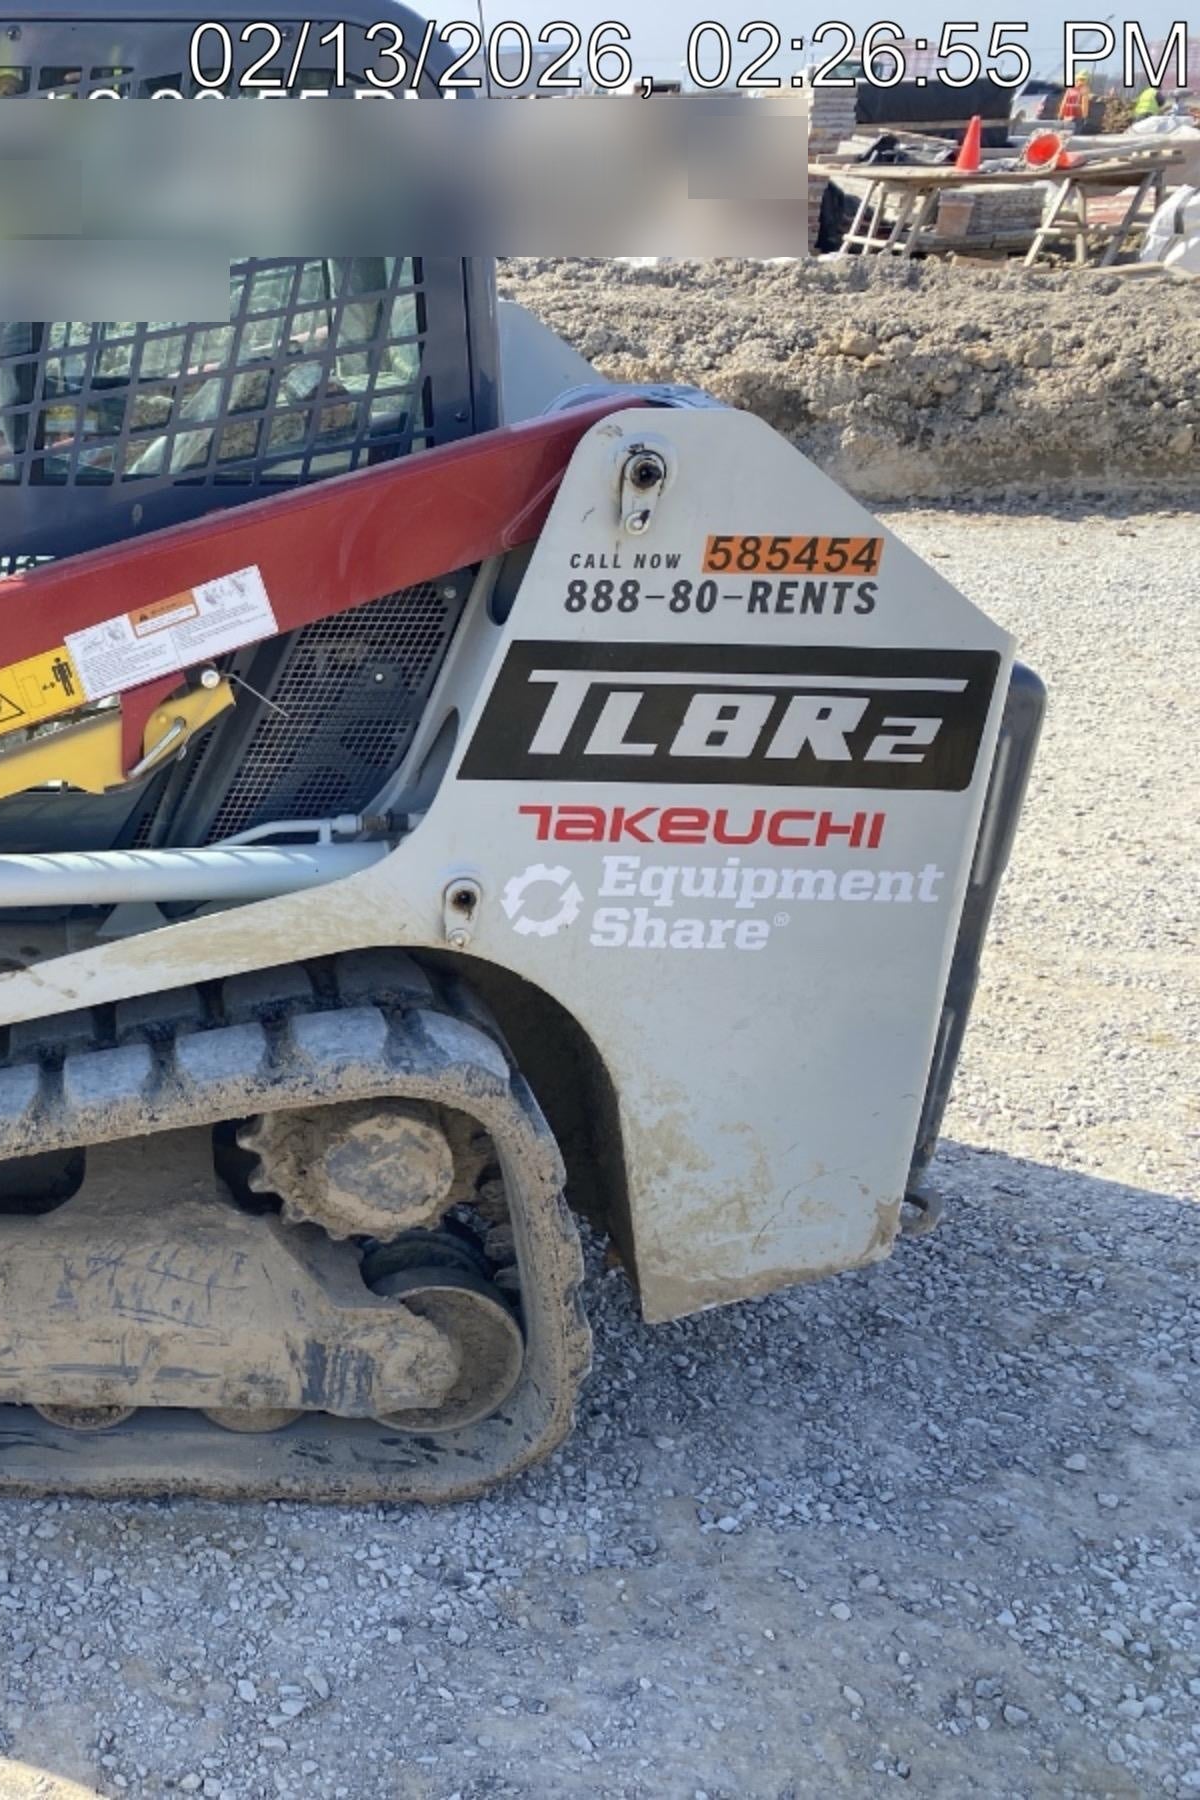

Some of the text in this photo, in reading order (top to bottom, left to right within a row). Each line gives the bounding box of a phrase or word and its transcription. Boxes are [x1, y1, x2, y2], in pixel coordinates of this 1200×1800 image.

[569, 553, 682, 569] CALL NOW
[707, 535, 878, 573] 585454
[564, 579, 879, 615] 888-80-RENTS
[527, 669, 970, 763] TL8R2
[597, 855, 945, 909] Equipment
